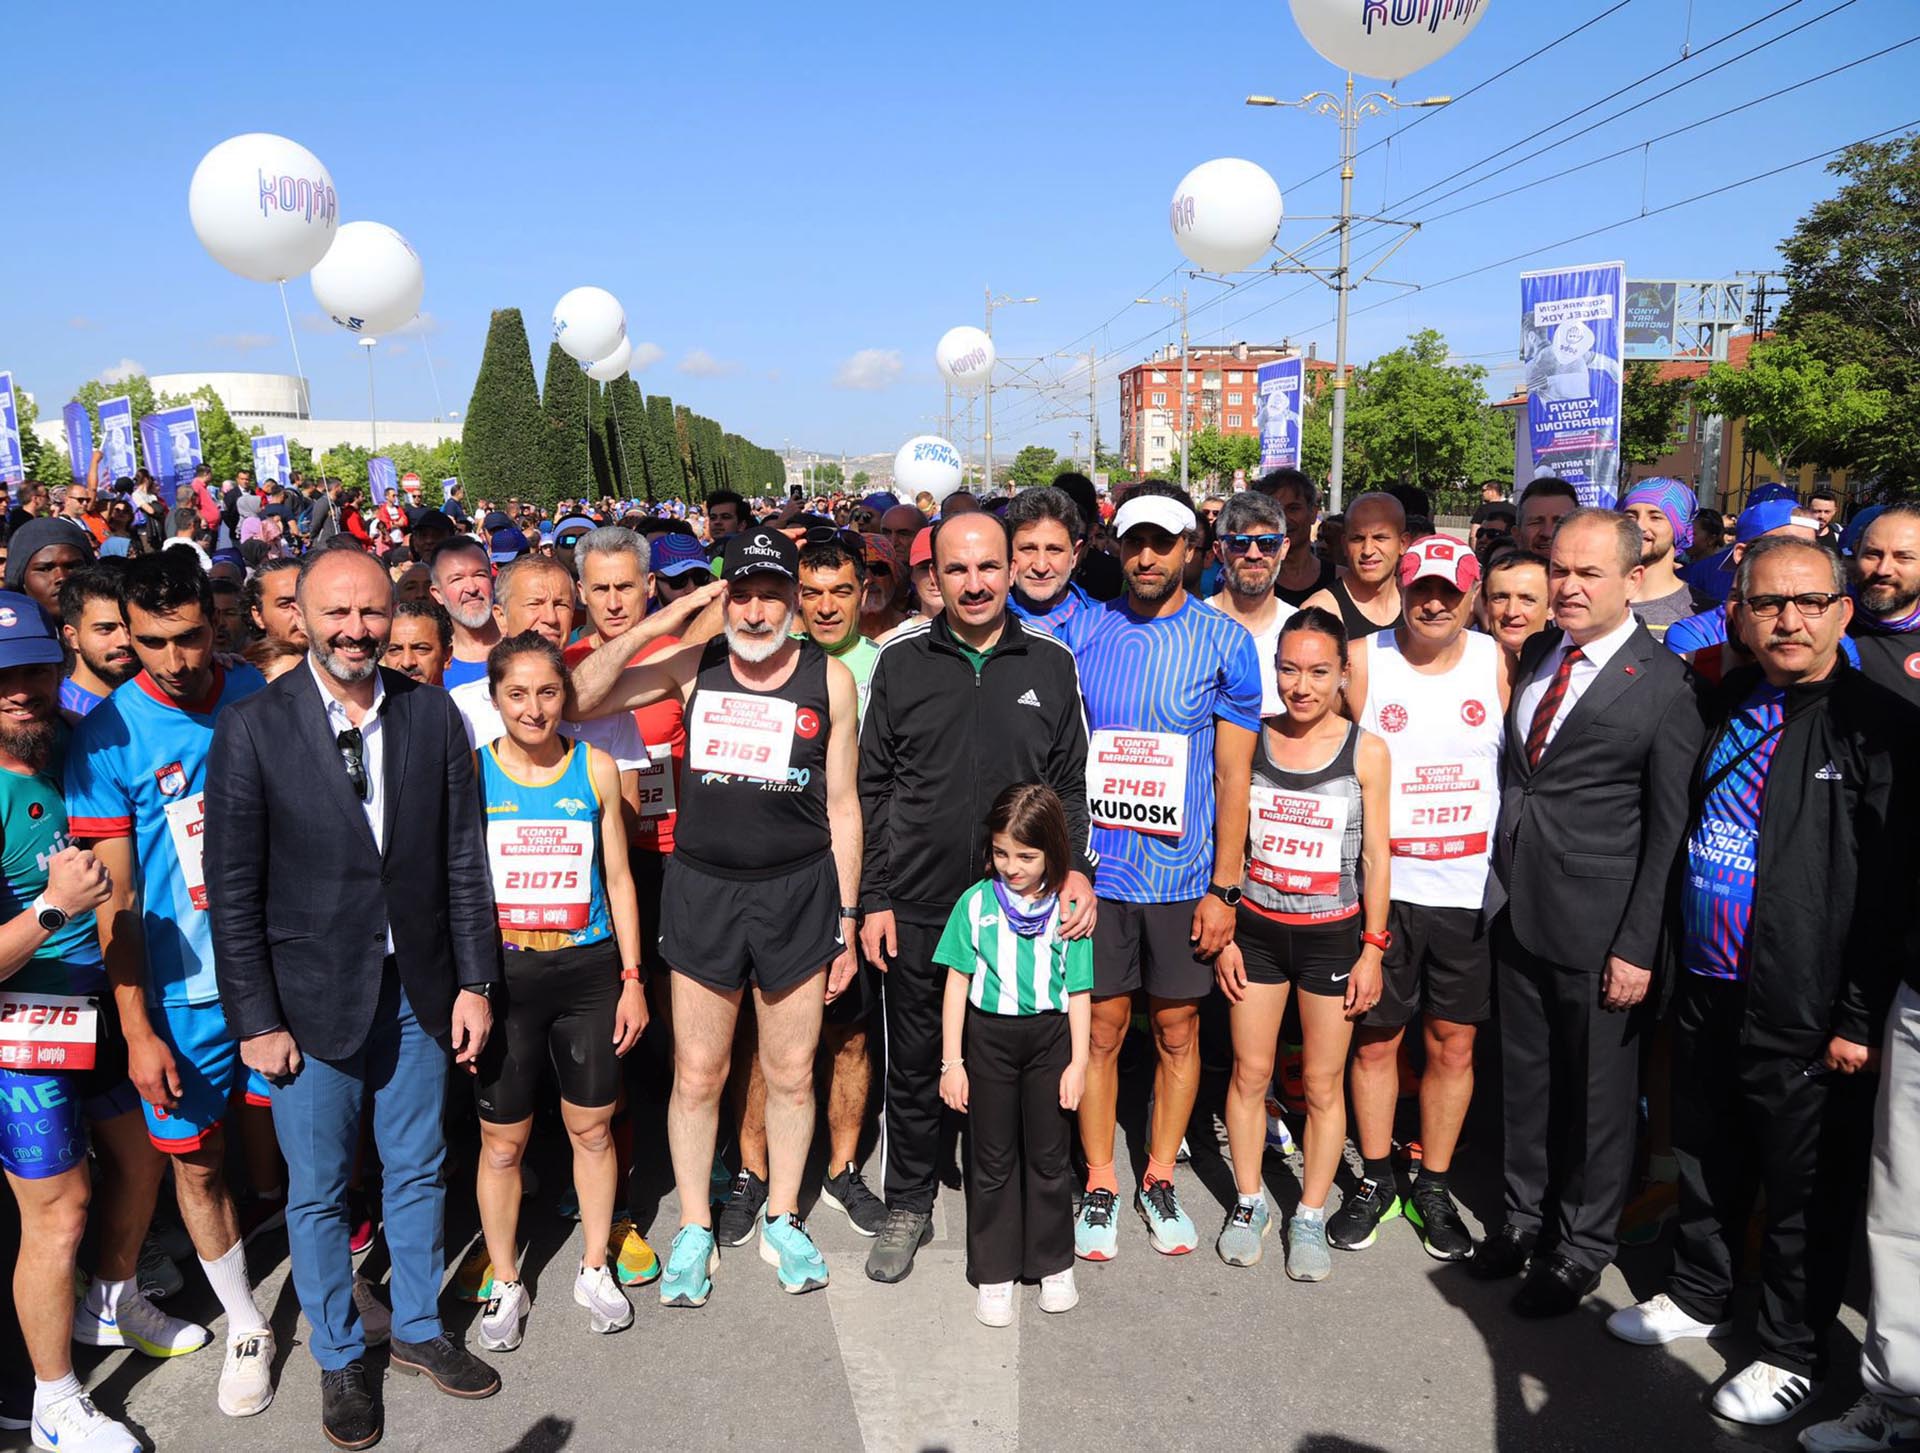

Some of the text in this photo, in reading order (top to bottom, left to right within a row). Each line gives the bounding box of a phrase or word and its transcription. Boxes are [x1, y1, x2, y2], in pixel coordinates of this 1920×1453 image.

[1627, 307, 1660, 315] KONYA
[1625, 321, 1670, 329] ARATONU
[743, 545, 782, 560] TÜRKİYE
[1116, 738, 1156, 748] KONYA
[705, 738, 771, 763] 21169
[1122, 747, 1150, 756] YARI
[1102, 754, 1170, 765] MARATONU
[1418, 766, 1461, 776] KONYA
[1425, 774, 1455, 784] YARI
[1103, 778, 1167, 798] 21481
[1405, 780, 1476, 792] MARATONU
[1275, 797, 1317, 809] KONYA
[1090, 798, 1178, 825] KUDOSK
[1281, 806, 1309, 817] YARI
[1411, 804, 1473, 825] 21217
[1262, 811, 1330, 827] MARATONU
[519, 828, 564, 837] KONYA
[527, 837, 557, 845] YARI
[1262, 834, 1324, 858] 21541
[1705, 832, 1749, 854] YARI
[505, 844, 579, 854] MARATONU
[505, 871, 578, 889] 21075
[1311, 909, 1343, 920] NIKE
[1, 1002, 80, 1026] 21276
